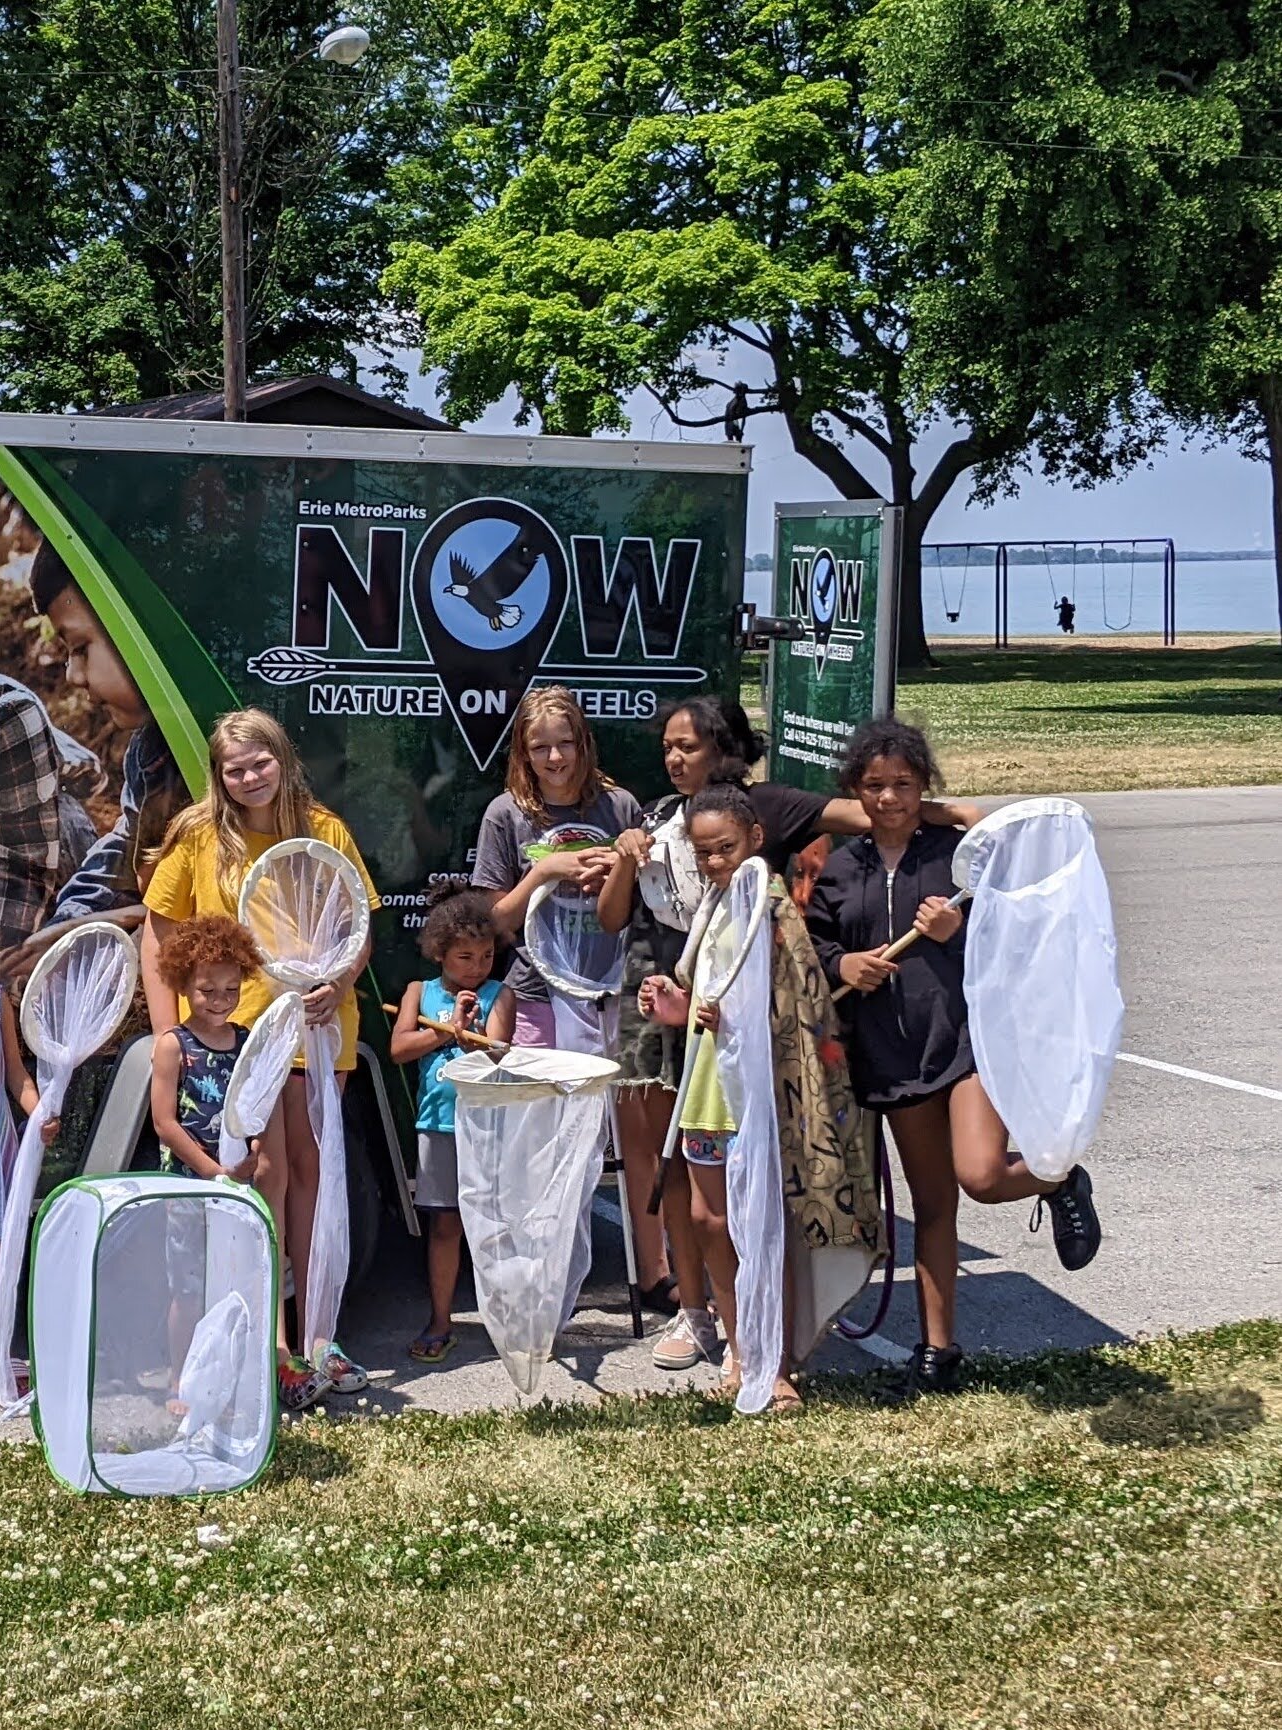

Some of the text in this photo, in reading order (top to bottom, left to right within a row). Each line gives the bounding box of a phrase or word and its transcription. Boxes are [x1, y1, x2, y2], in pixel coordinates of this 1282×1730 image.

[299, 501, 427, 519] Erie MetroParks
[790, 641, 814, 658] NATURE
[826, 643, 854, 661] WHEELS
[308, 684, 657, 719] NATURE ON EELS
